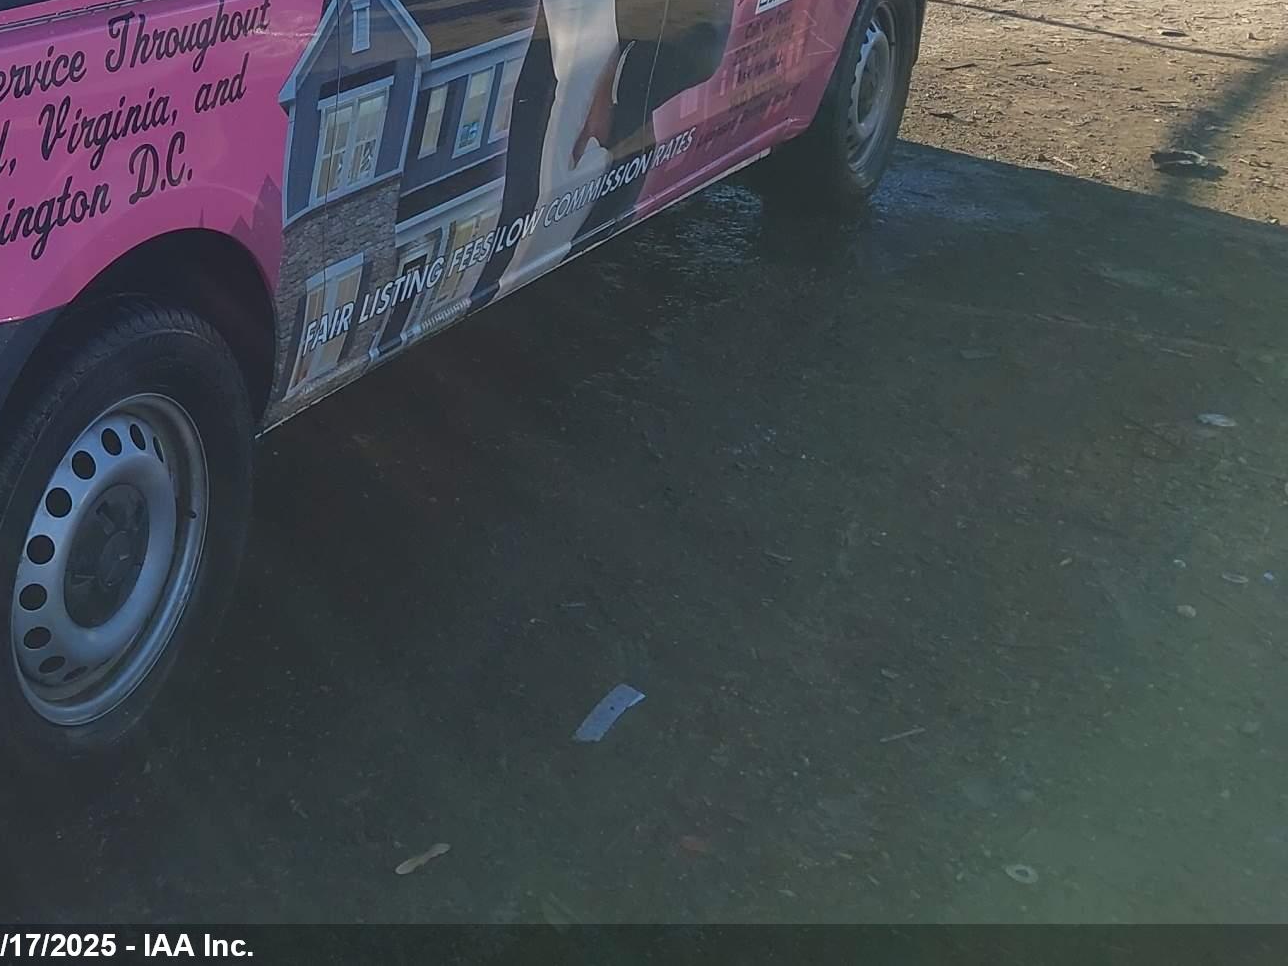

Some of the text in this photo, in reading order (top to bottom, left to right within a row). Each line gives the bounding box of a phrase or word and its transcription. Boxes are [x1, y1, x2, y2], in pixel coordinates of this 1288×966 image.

[38, 87, 178, 170] Virginia,
[194, 52, 248, 114] and
[129, 131, 193, 205] D.C.
[301, 301, 355, 357] FAIR
[358, 256, 445, 324] LISTING
[543, 150, 653, 228] COMMISSION
[652, 126, 696, 168] RATES
